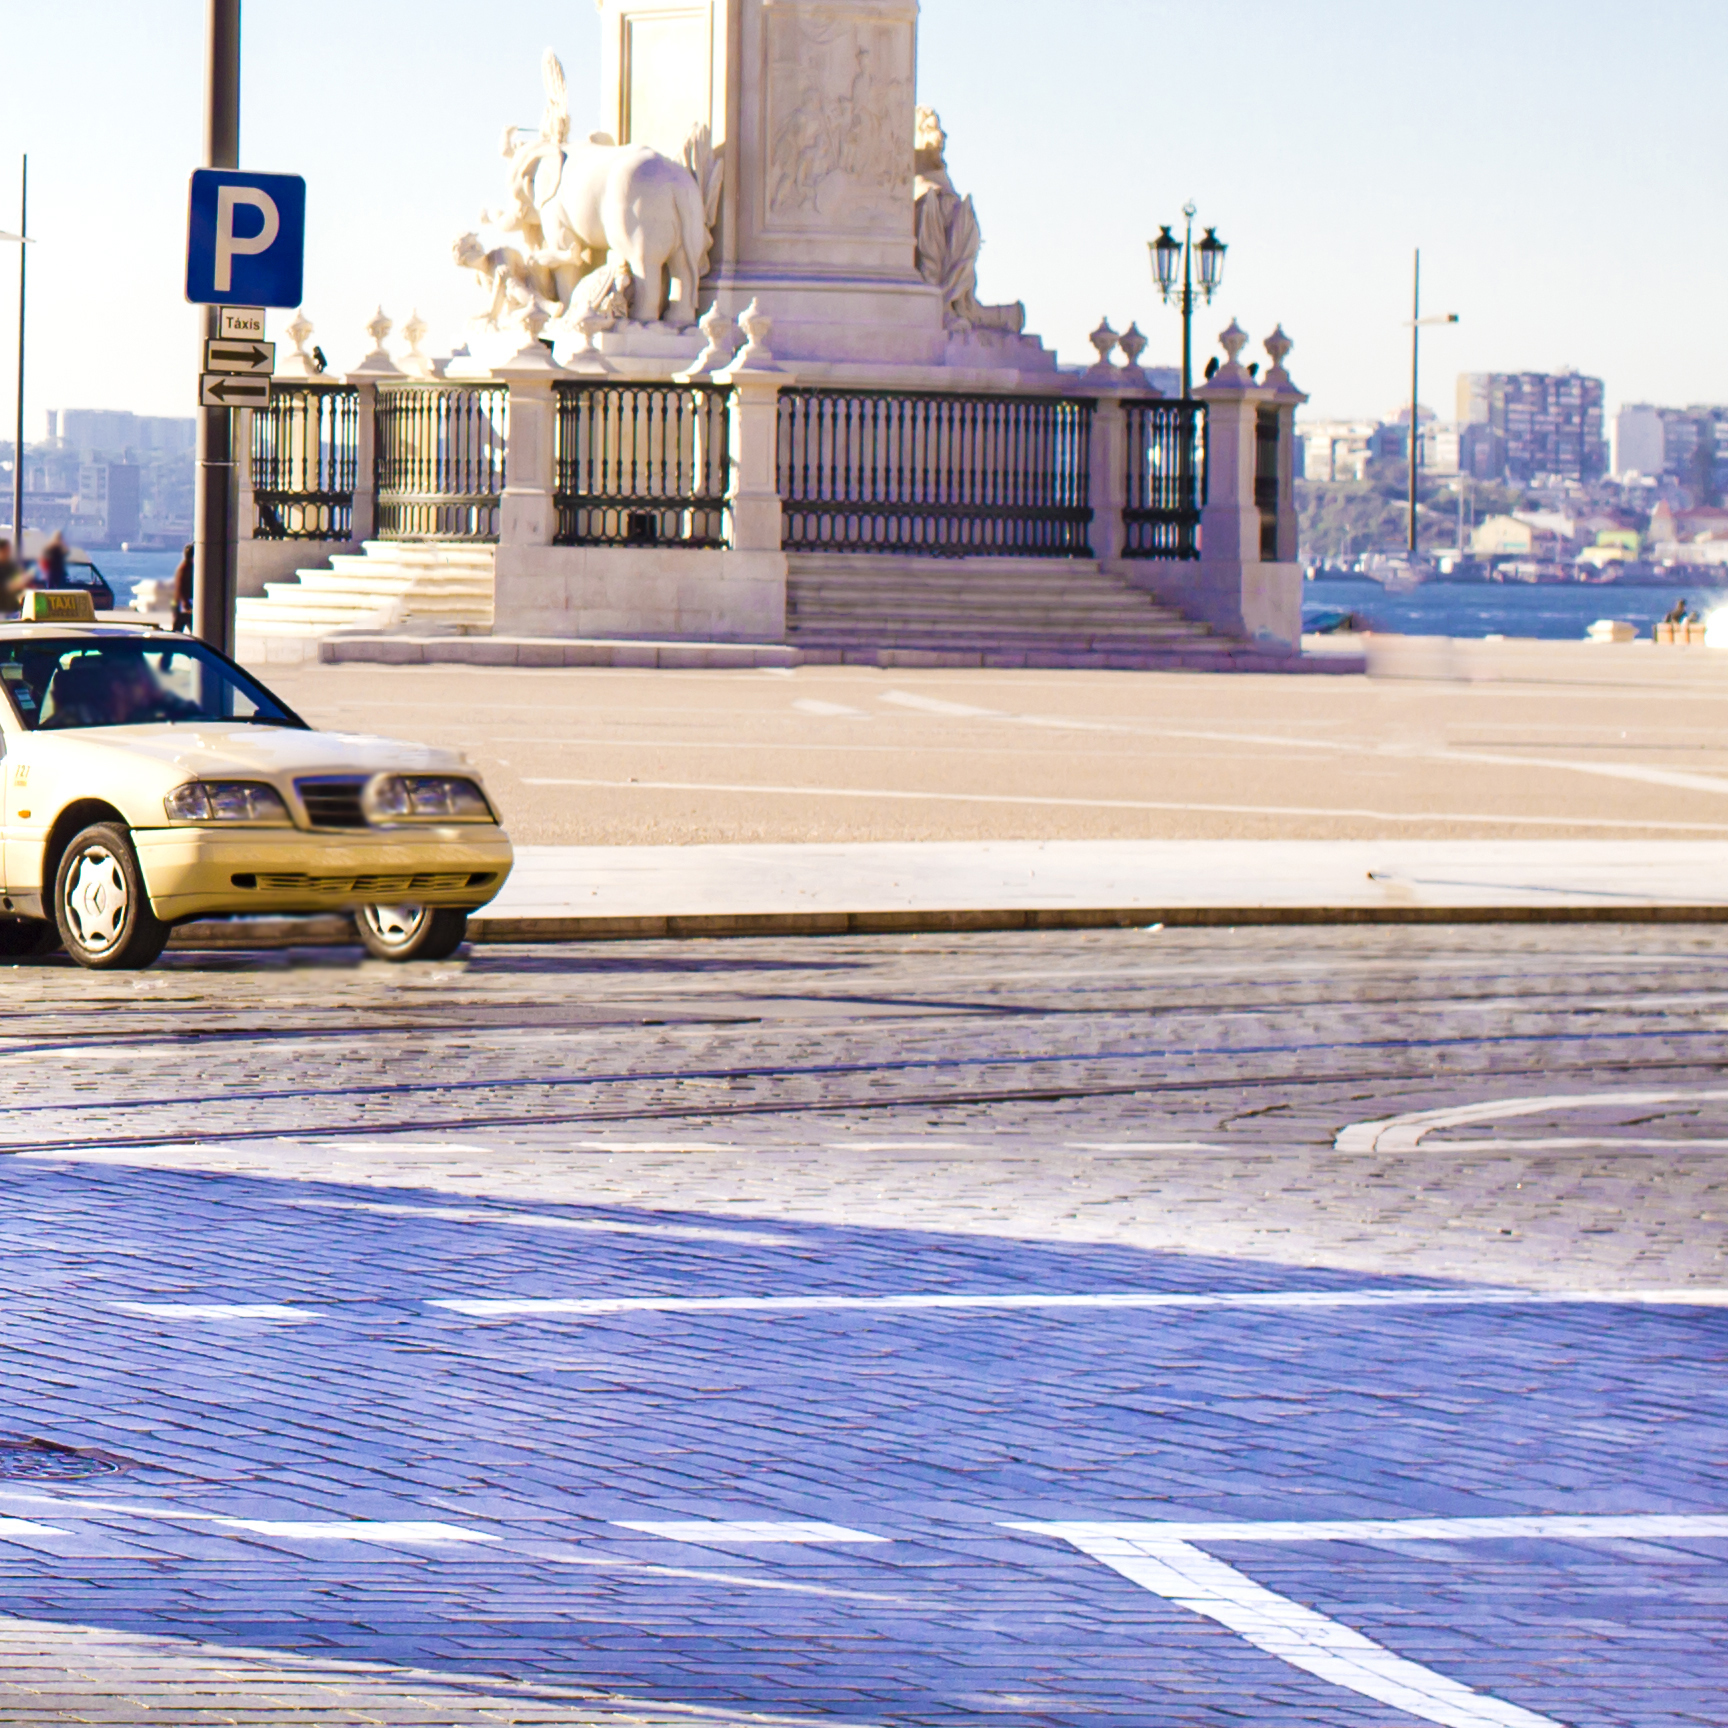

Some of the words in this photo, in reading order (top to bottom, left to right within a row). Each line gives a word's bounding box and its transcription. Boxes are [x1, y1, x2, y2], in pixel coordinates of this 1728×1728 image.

[214, 185, 280, 292] P
[225, 316, 261, 331] Táxis
[48, 595, 76, 610] TAXI
